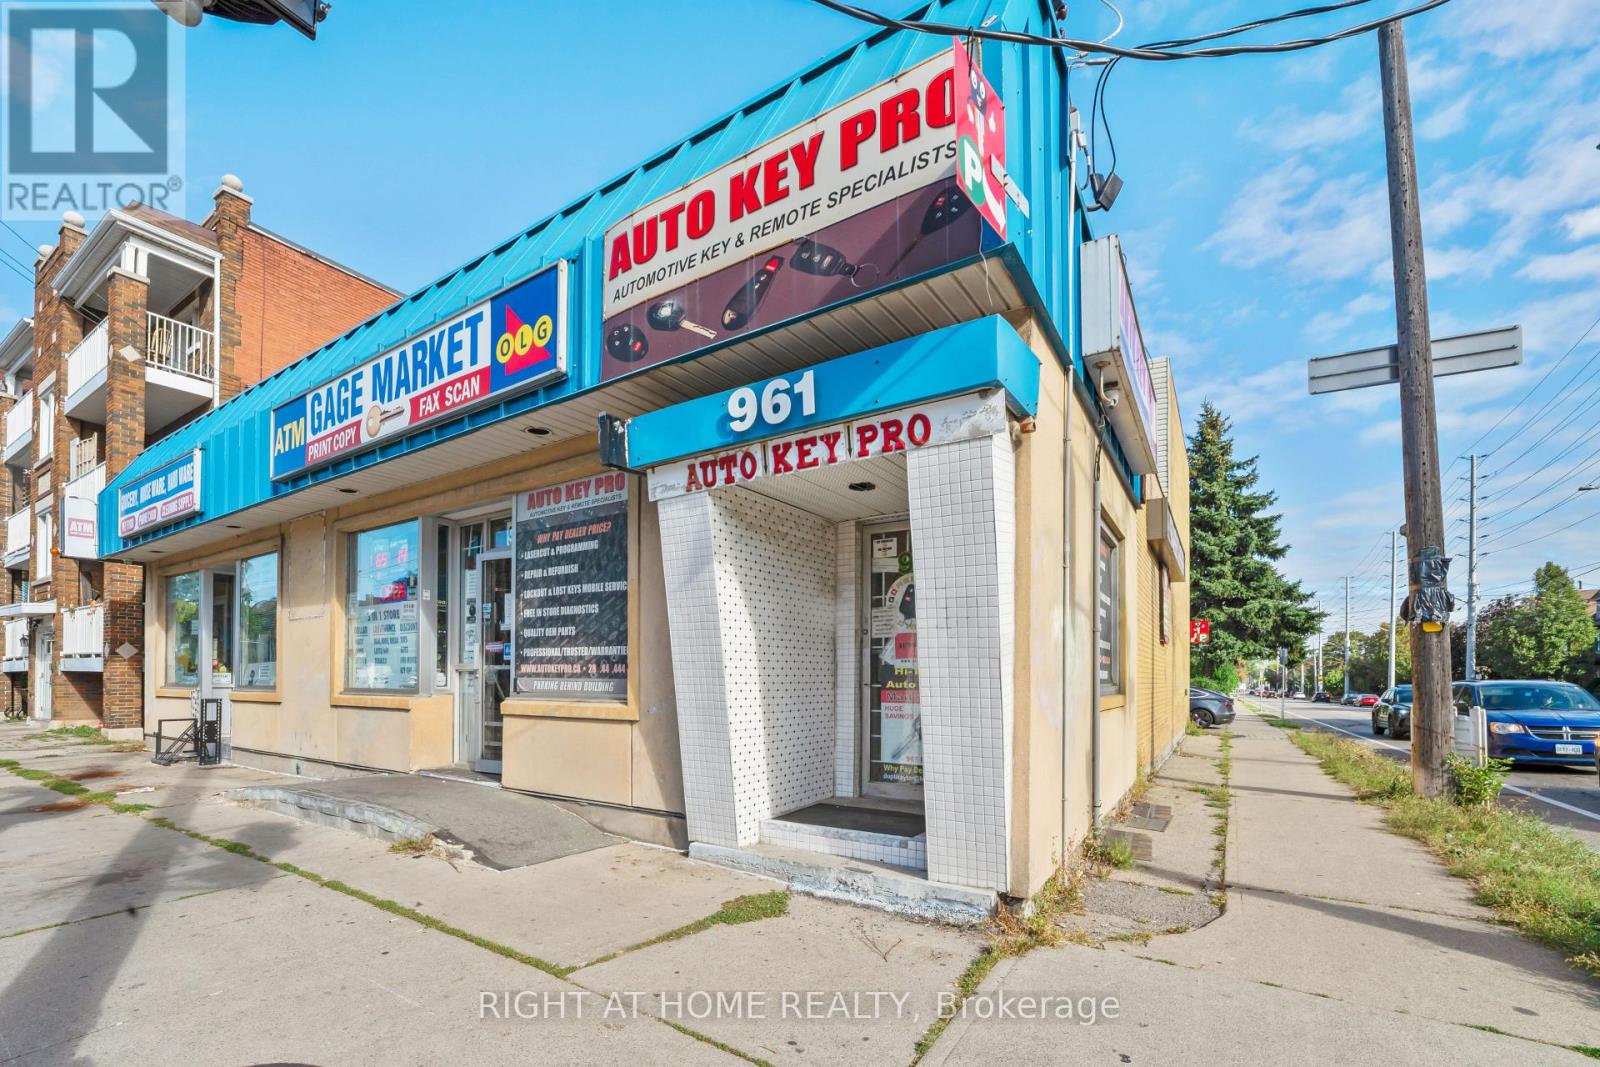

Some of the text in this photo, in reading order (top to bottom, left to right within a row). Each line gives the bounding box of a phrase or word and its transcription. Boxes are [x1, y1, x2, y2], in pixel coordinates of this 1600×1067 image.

[609, 66, 956, 282] AUTO KEY PRO
[964, 138, 982, 191] P
[612, 139, 958, 304] AUTOMOTIVE KEY & REMOTE SPECIALISTS
[498, 318, 550, 359] OLG
[310, 310, 485, 437] GAGE MARKET
[418, 374, 481, 418] FAX SCAN
[727, 369, 817, 433] 961
[273, 416, 306, 457] ATM
[307, 425, 358, 462] PRINT COPY
[685, 412, 933, 493] AUTO KEY PRO
[527, 471, 626, 511] AUTO KEY PRO
[524, 540, 598, 559] LASERCUT & PROGRAMMING
[537, 521, 611, 544] WHY PAY DEALER PRICE?
[524, 567, 542, 579] REPAIR
[548, 563, 579, 576] REFURBISH
[523, 588, 547, 599] LOCKOUT
[553, 586, 567, 596] LOST
[567, 584, 582, 595] KEYS
[582, 583, 604, 593] MOBILE
[383, 608, 400, 620] STORE
[523, 604, 599, 618] FREE IN STORE DIAGNOSTICS
[523, 628, 544, 638] QUALITY
[557, 626, 576, 636] PARTS
[533, 680, 615, 692] PARKING BEHIND BUILDING
[886, 680, 916, 689] Auto
[883, 764, 899, 774] Why
[900, 765, 912, 775] Pay
